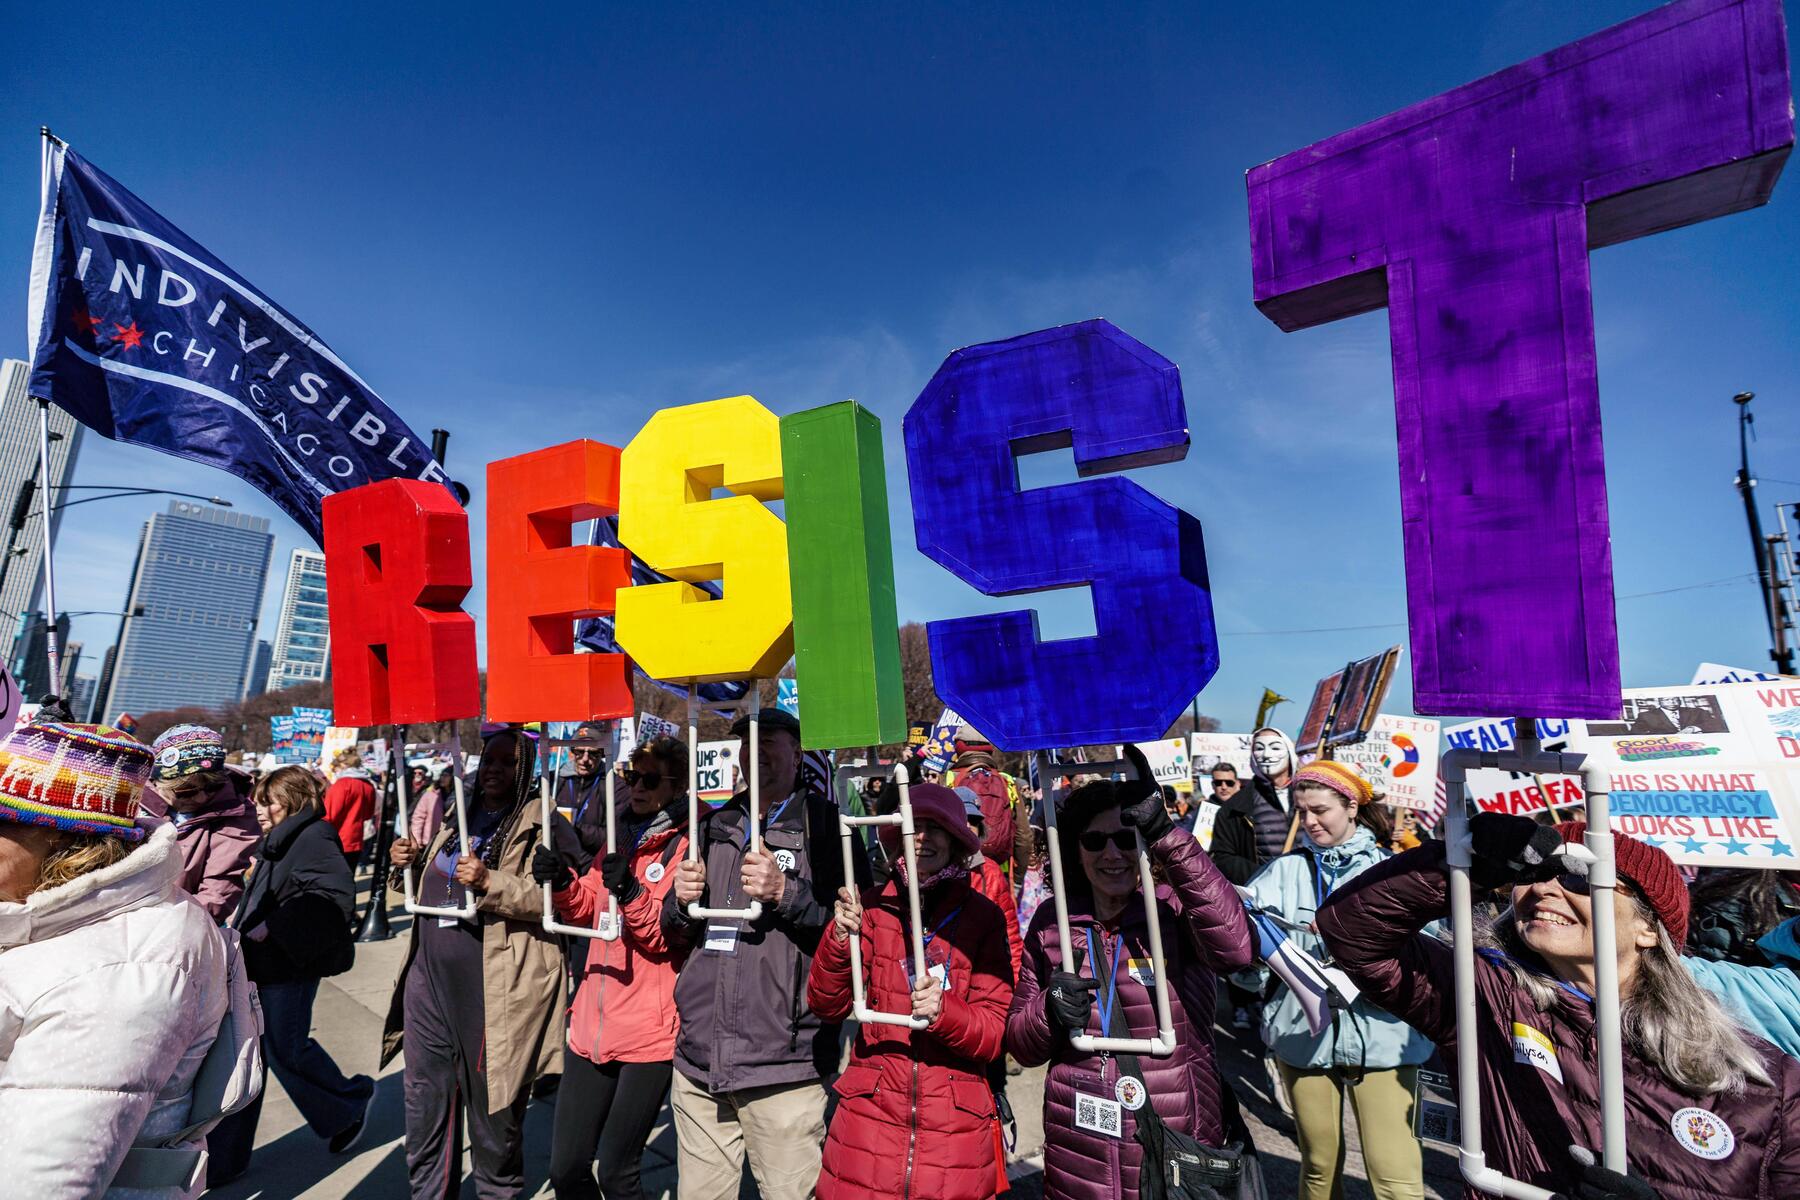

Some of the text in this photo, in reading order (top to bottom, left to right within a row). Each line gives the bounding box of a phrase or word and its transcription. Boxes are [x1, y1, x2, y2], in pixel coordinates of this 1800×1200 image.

[74, 247, 448, 483] INDIVISIBLE
[322, 0, 1794, 752] RESIST
[153, 331, 354, 478] CHICAGO
[1383, 719, 1434, 732] VETO
[1374, 731, 1391, 741] ICE
[1617, 737, 1670, 748] Good
[1368, 743, 1389, 752] THE
[1620, 743, 1692, 755] Trouble
[1624, 750, 1678, 761] Lives
[697, 750, 718, 768] UMP
[1152, 761, 1188, 778] archy
[697, 768, 724, 790] CKS!
[1610, 774, 1756, 792] HIS IS WHAT
[1478, 778, 1583, 815] WARFA
[1609, 794, 1762, 815] DEMOCRACY
[1620, 814, 1779, 839] OOKS LIKE
[775, 853, 792, 865] ICE
